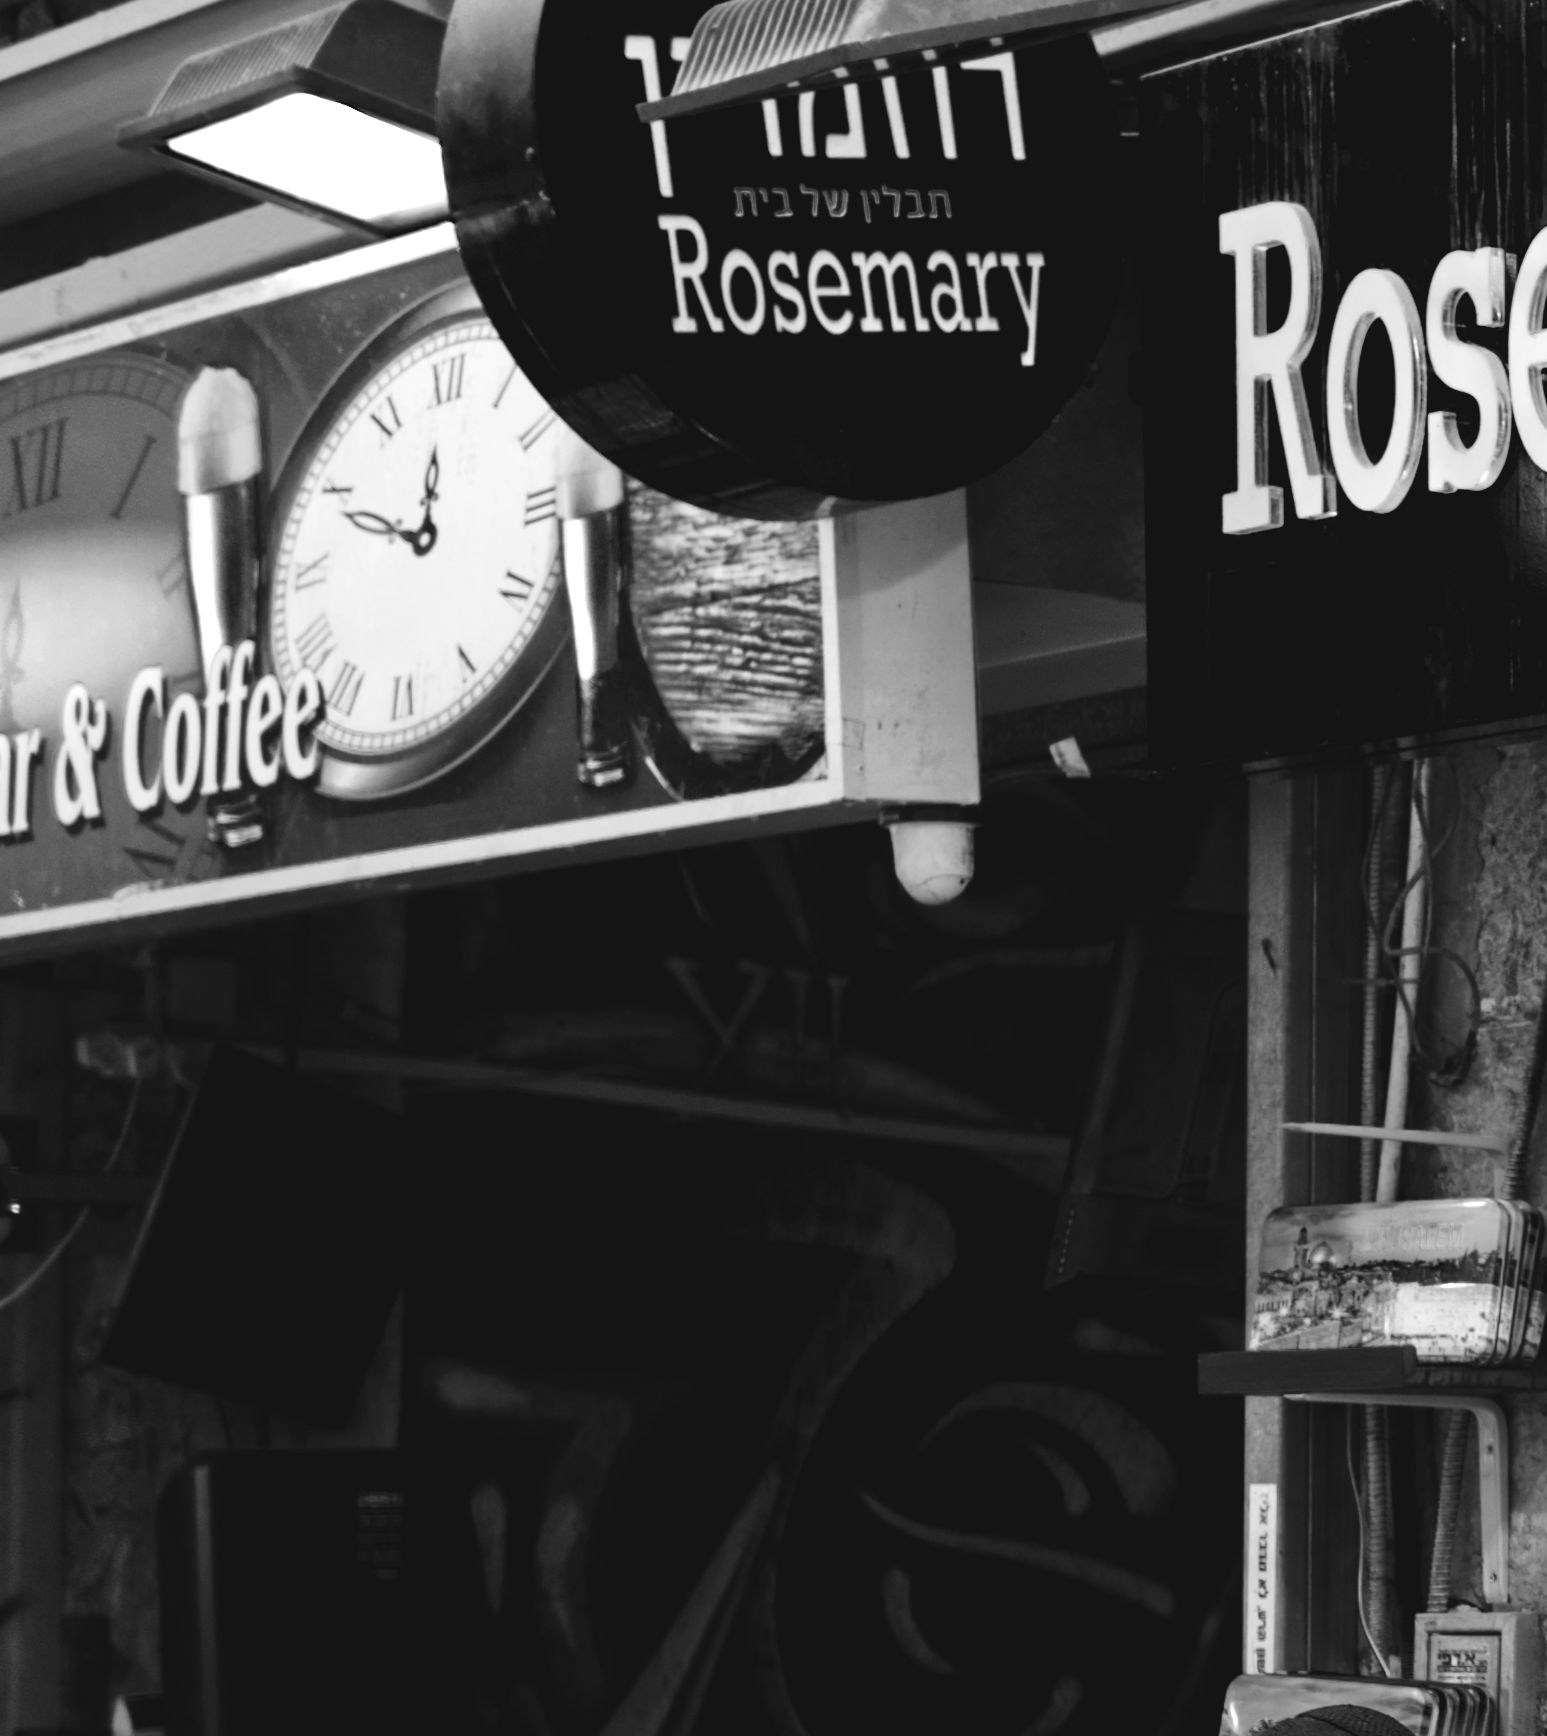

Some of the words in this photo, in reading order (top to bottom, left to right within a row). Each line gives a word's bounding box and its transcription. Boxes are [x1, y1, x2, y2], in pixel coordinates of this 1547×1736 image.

[733, 186, 794, 218] בית
[800, 183, 850, 218] של
[861, 183, 953, 224] תבלין
[657, 213, 1046, 367] Rosemary
[53, 681, 107, 828] &
[122, 639, 327, 814] Coffee
